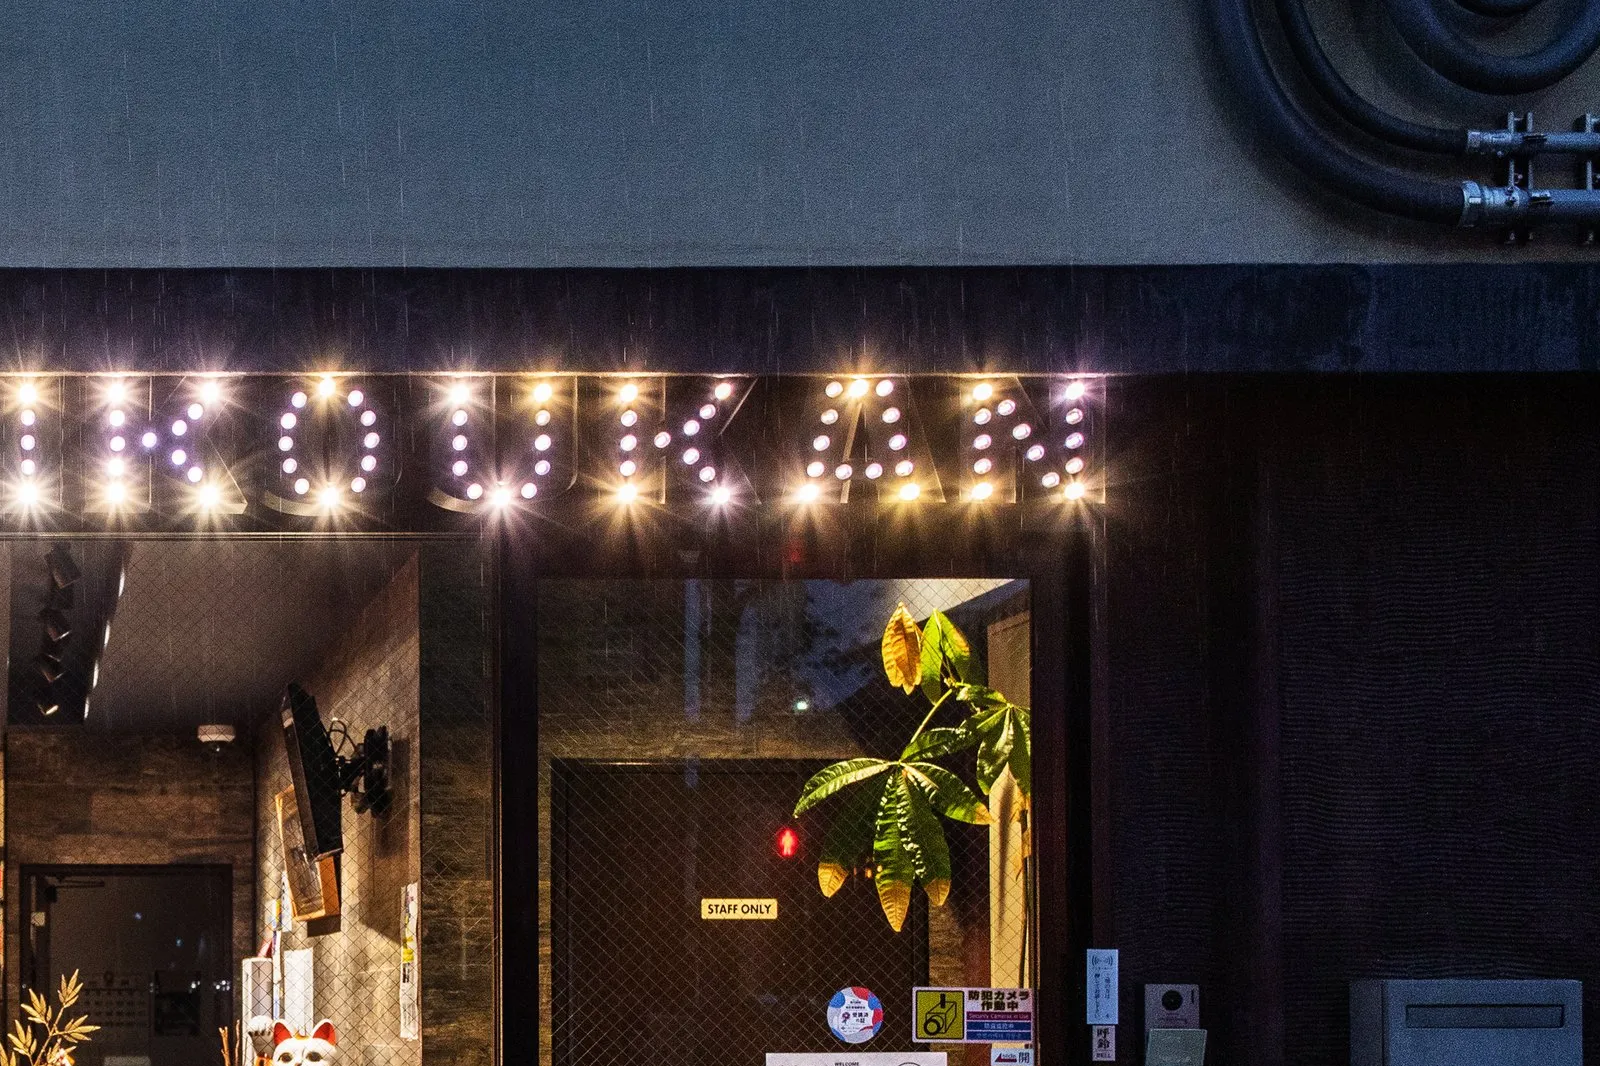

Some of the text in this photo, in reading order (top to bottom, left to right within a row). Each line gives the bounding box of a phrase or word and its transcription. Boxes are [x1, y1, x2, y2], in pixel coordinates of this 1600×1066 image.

[708, 904, 771, 914] STAFF ONLY
[968, 990, 1030, 1001] 防犯カメラ
[981, 1001, 1019, 1011] 作動中
[1018, 1052, 1030, 1064] 開
